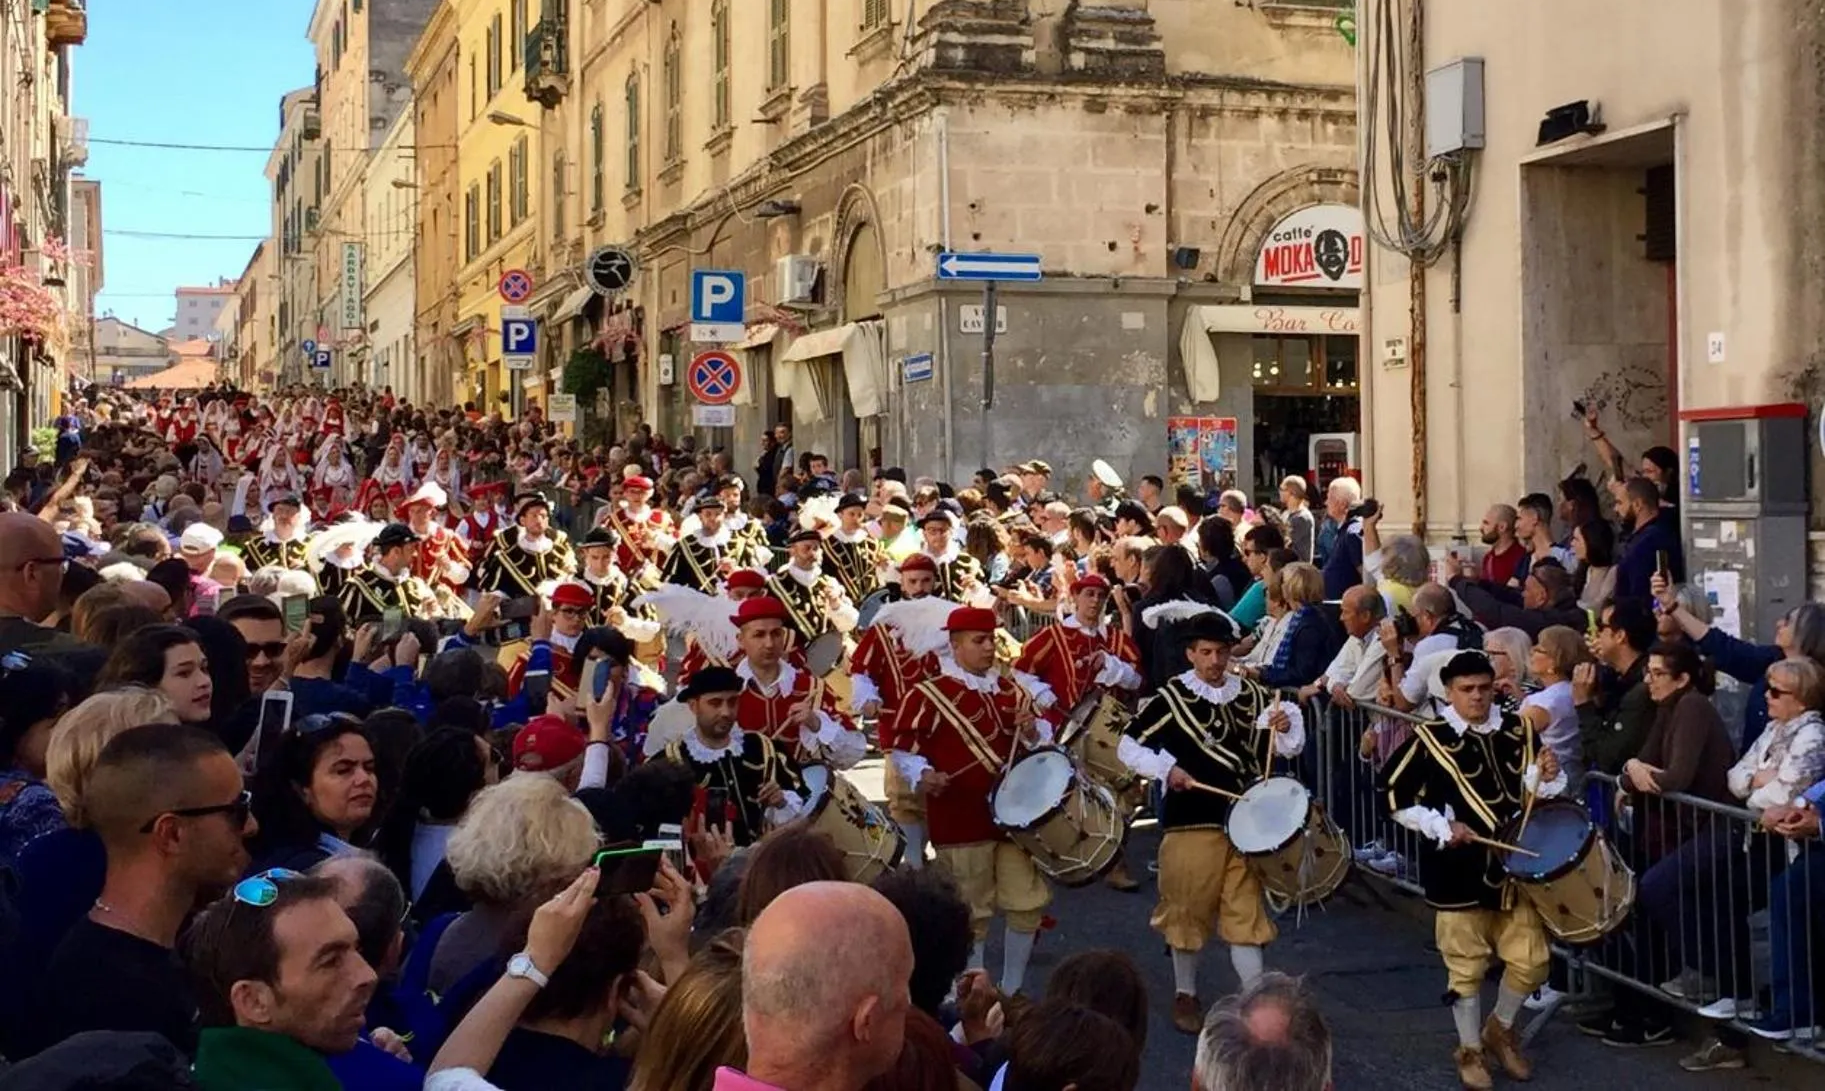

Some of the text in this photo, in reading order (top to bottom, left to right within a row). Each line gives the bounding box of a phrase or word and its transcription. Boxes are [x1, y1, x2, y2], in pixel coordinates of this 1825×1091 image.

[1264, 242, 1315, 280] MOKA
[701, 276, 735, 318] P
[1254, 309, 1307, 331] Bar
[509, 323, 530, 350] P
